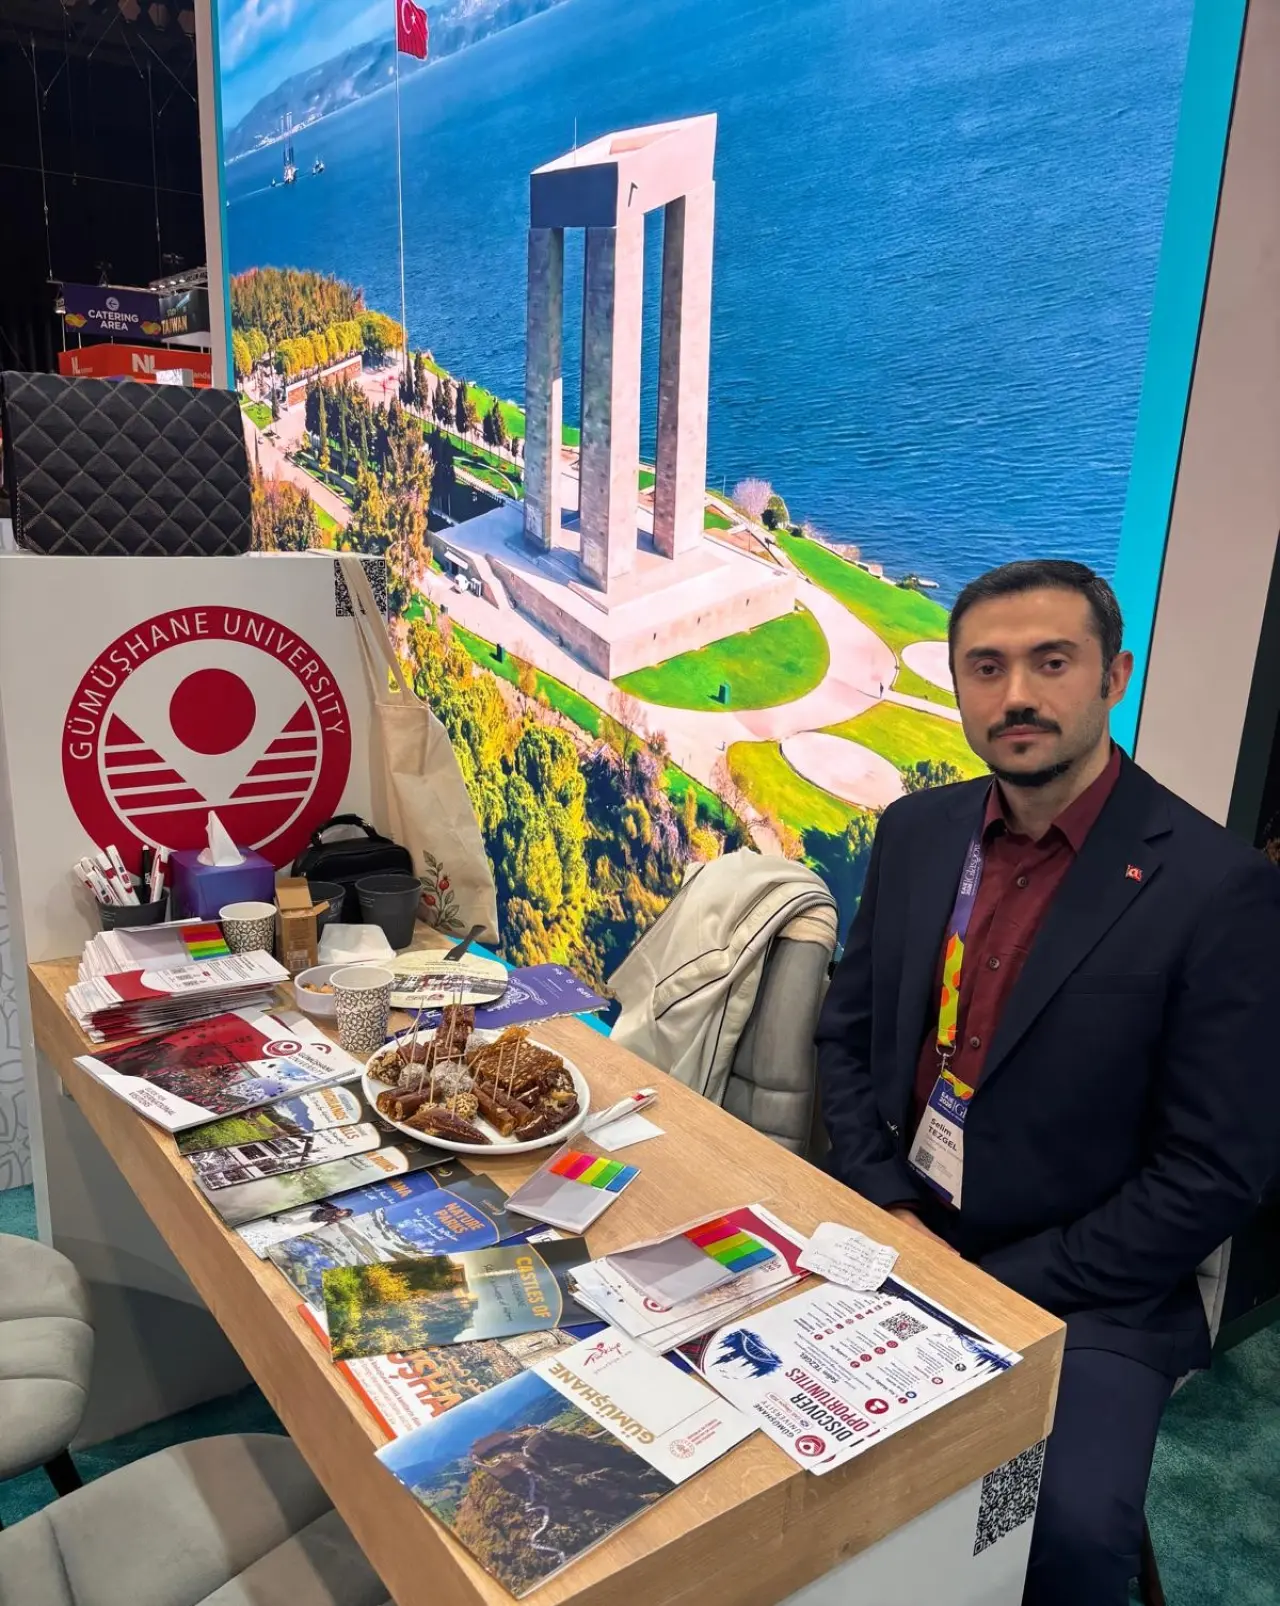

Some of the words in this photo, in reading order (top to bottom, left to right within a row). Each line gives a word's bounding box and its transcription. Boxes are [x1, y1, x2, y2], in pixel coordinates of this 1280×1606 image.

[88, 309, 139, 323] CATERING
[100, 319, 129, 332] AREA
[161, 315, 188, 336] TAIWAN
[69, 612, 209, 760] GÜMÜŞHANE
[224, 613, 345, 735] UNIVERSITY
[939, 1097, 953, 1109] 2026
[928, 1126, 957, 1151] TEZGEL
[930, 1118, 952, 1137] Selim
[434, 1209, 468, 1234] PARKS
[445, 1202, 485, 1231] NATURE
[516, 1256, 545, 1304] CASTLES
[531, 1305, 552, 1318] OF
[799, 1352, 822, 1371] TEZGEL
[822, 1370, 839, 1384] Selim
[548, 1362, 657, 1446] GÜMÜŞHANE
[785, 1367, 870, 1432] OPPORTUNITIES
[753, 1404, 795, 1438] GÜMÜŞHANE
[760, 1400, 802, 1434] UNIVERSITY
[790, 1392, 854, 1442] DISCOVER
